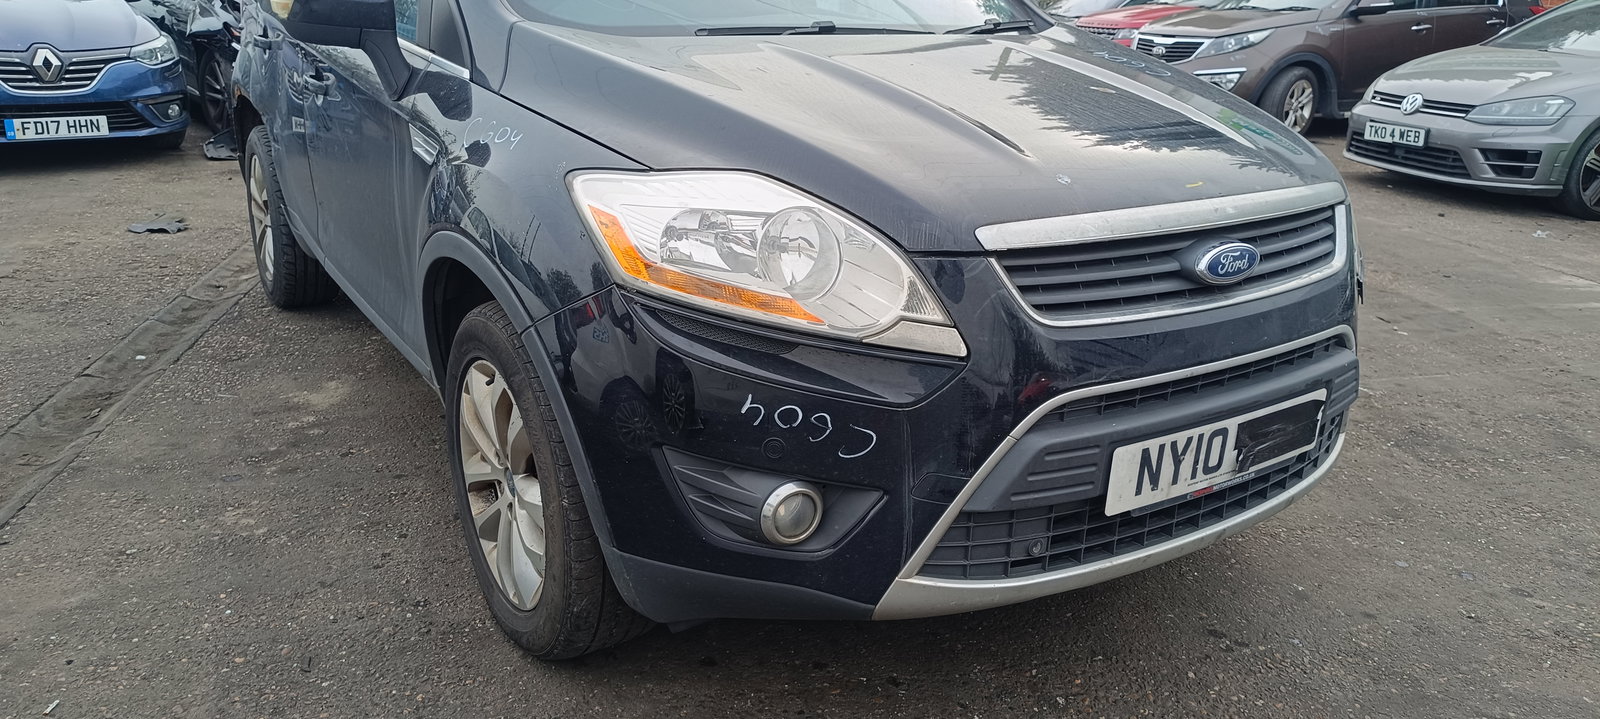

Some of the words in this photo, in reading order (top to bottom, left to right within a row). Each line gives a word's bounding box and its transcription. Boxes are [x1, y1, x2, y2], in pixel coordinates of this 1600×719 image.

[21, 119, 60, 136] FD17
[66, 118, 100, 134] HHN
[1218, 251, 1249, 275] Ford
[1134, 426, 1230, 497] NY10
